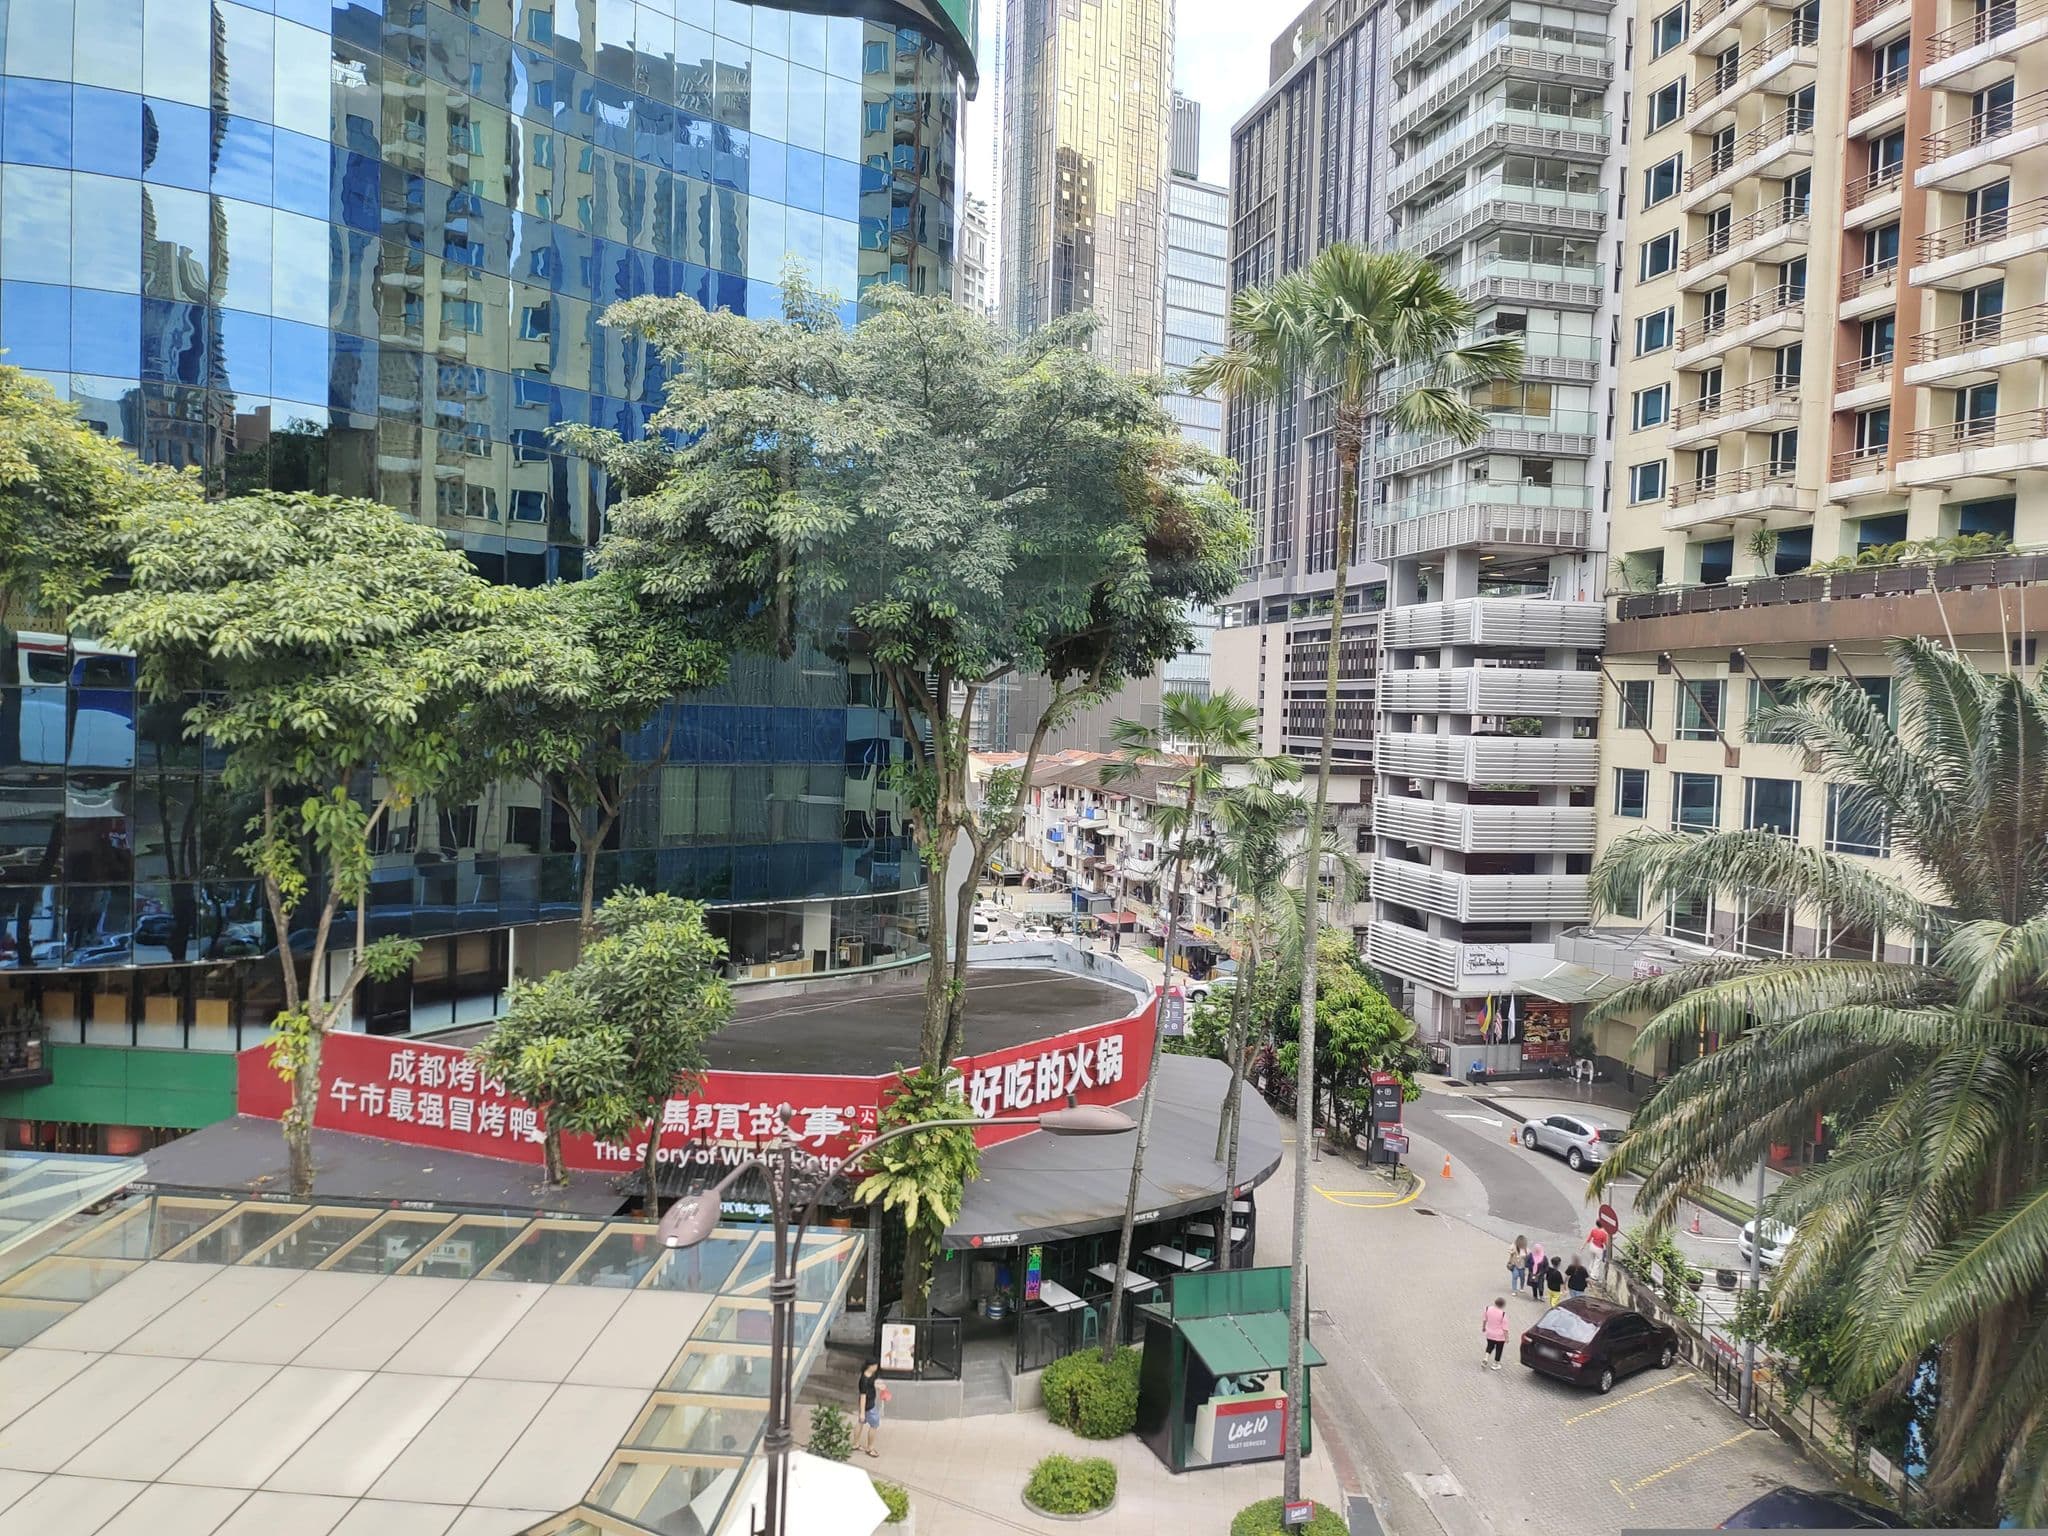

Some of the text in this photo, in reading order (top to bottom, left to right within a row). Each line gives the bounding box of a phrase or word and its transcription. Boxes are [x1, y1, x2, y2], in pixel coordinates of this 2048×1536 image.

[593, 1141, 631, 1161] The
[635, 1142, 691, 1169] Sory
[695, 1146, 718, 1165] of
